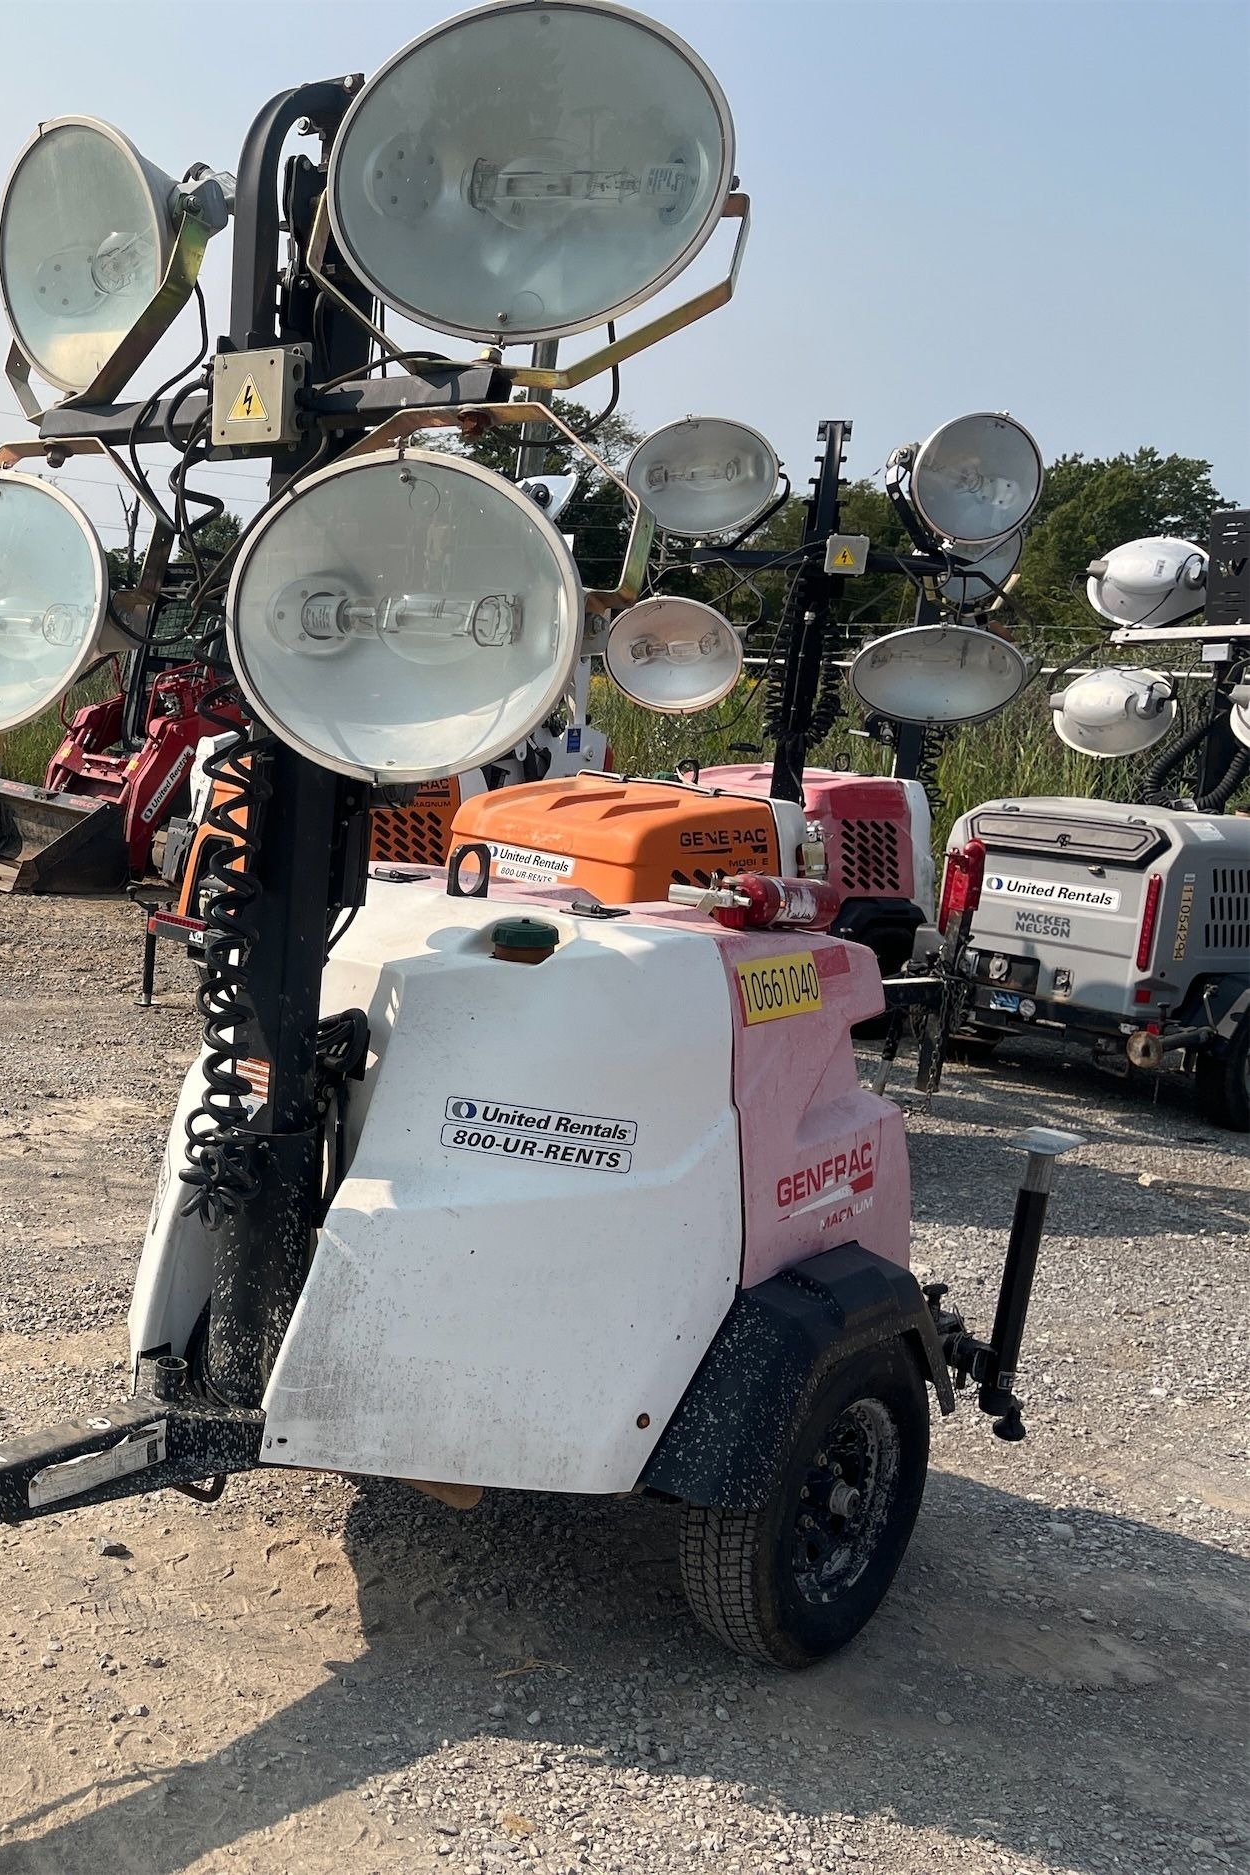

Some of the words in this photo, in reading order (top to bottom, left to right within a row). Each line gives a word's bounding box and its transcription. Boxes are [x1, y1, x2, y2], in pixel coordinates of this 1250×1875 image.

[151, 779, 172, 808] United
[500, 848, 532, 864] United
[532, 855, 570, 872] Rentals
[729, 858, 769, 868] MOBIE
[1006, 879, 1055, 897] United
[1057, 887, 1113, 905] Rentals
[1015, 922, 1070, 938] NEUSON
[1016, 911, 1070, 928] WACKER
[741, 962, 819, 1012] 10661040
[482, 1106, 551, 1130] United
[554, 1116, 628, 1141] Rentals
[452, 1130, 621, 1168] 800-UR-RENTS
